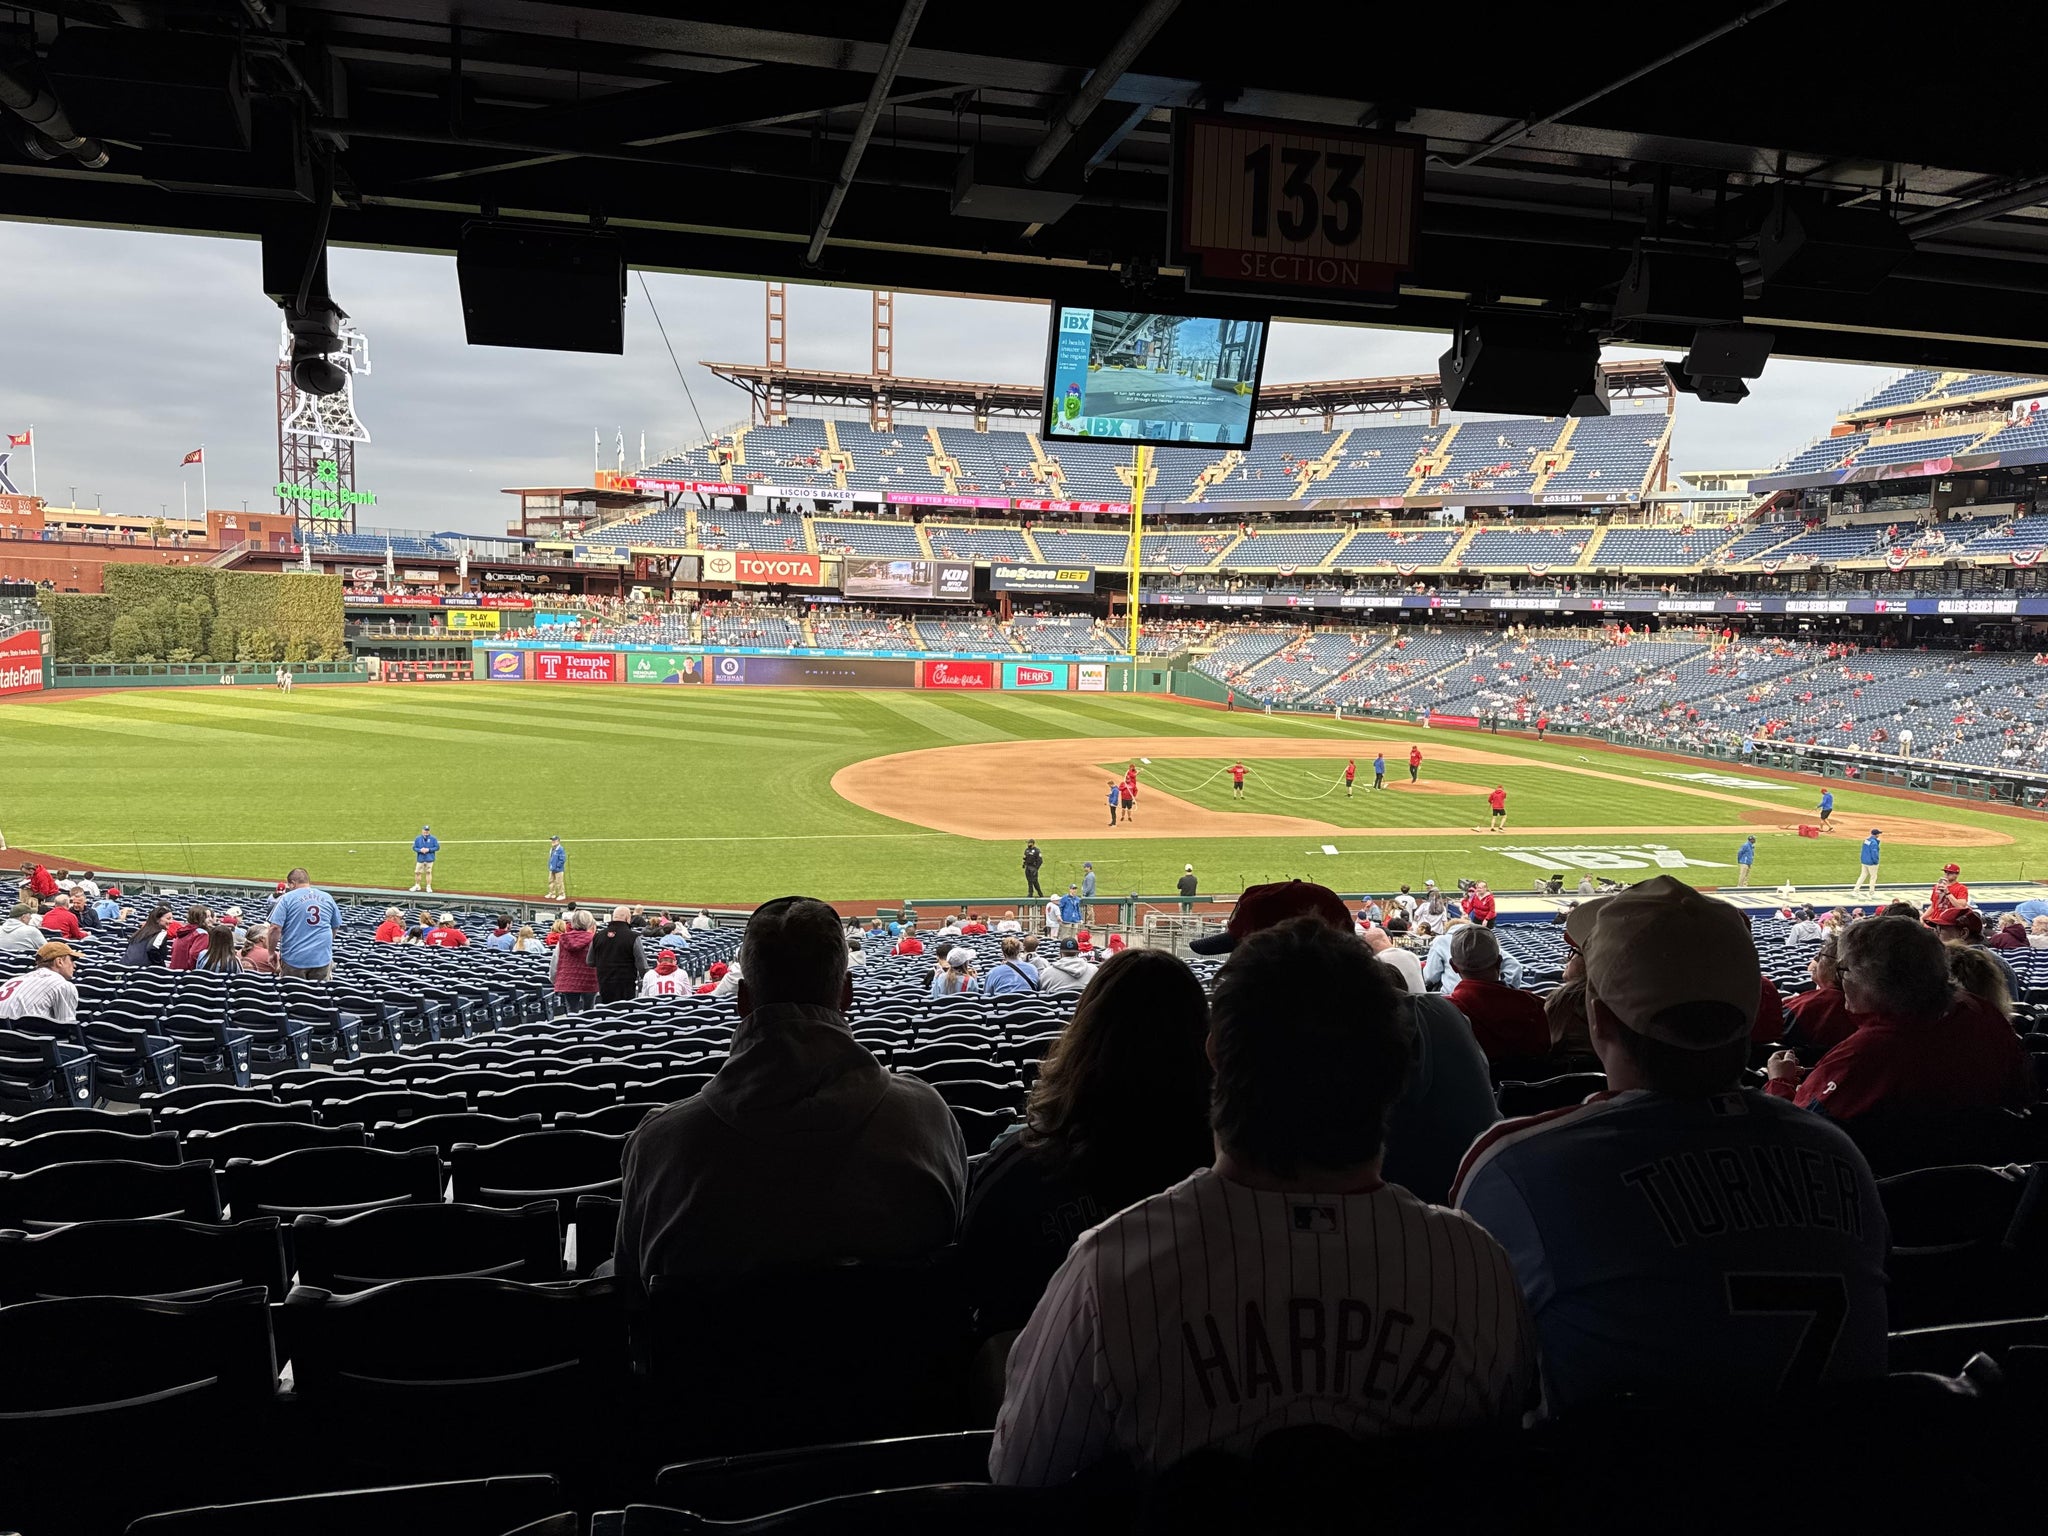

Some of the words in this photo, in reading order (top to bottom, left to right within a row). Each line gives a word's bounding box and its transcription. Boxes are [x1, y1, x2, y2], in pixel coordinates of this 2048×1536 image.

[1244, 144, 1365, 246] 133
[1241, 253, 1360, 285] SECTION
[1063, 316, 1089, 330] IBX
[1086, 418, 1124, 436] IBX
[636, 480, 664, 490] Phillies
[666, 482, 680, 490] win
[276, 482, 336, 502] Citizens
[340, 488, 377, 506] Bank
[780, 488, 821, 498] LISCIO'S
[824, 490, 858, 500] BAKERY
[891, 494, 913, 504] WHEY
[915, 496, 942, 505] BETTER
[944, 496, 976, 506] PROTEIN
[1571, 494, 1582, 502] PM
[312, 503, 344, 520] Park
[740, 559, 814, 577] TOYOTA
[995, 566, 1056, 580] theScore
[1060, 572, 1086, 580] BET
[565, 656, 610, 669] Temple
[0, 665, 42, 689] tateFarm
[220, 675, 235, 685] 401
[566, 668, 608, 680] Health
[932, 667, 984, 686] Chick-fil-A
[1020, 671, 1048, 682] HERR'S
[1082, 670, 1102, 678] WM
[1498, 850, 1740, 870] IBX
[306, 905, 320, 925] 3
[656, 980, 675, 994] 16
[1822, 1080, 1837, 1094] P
[1620, 1144, 1864, 1248] TURNER
[1720, 1271, 1850, 1393] 7
[1182, 1298, 1455, 1414] HARPER
